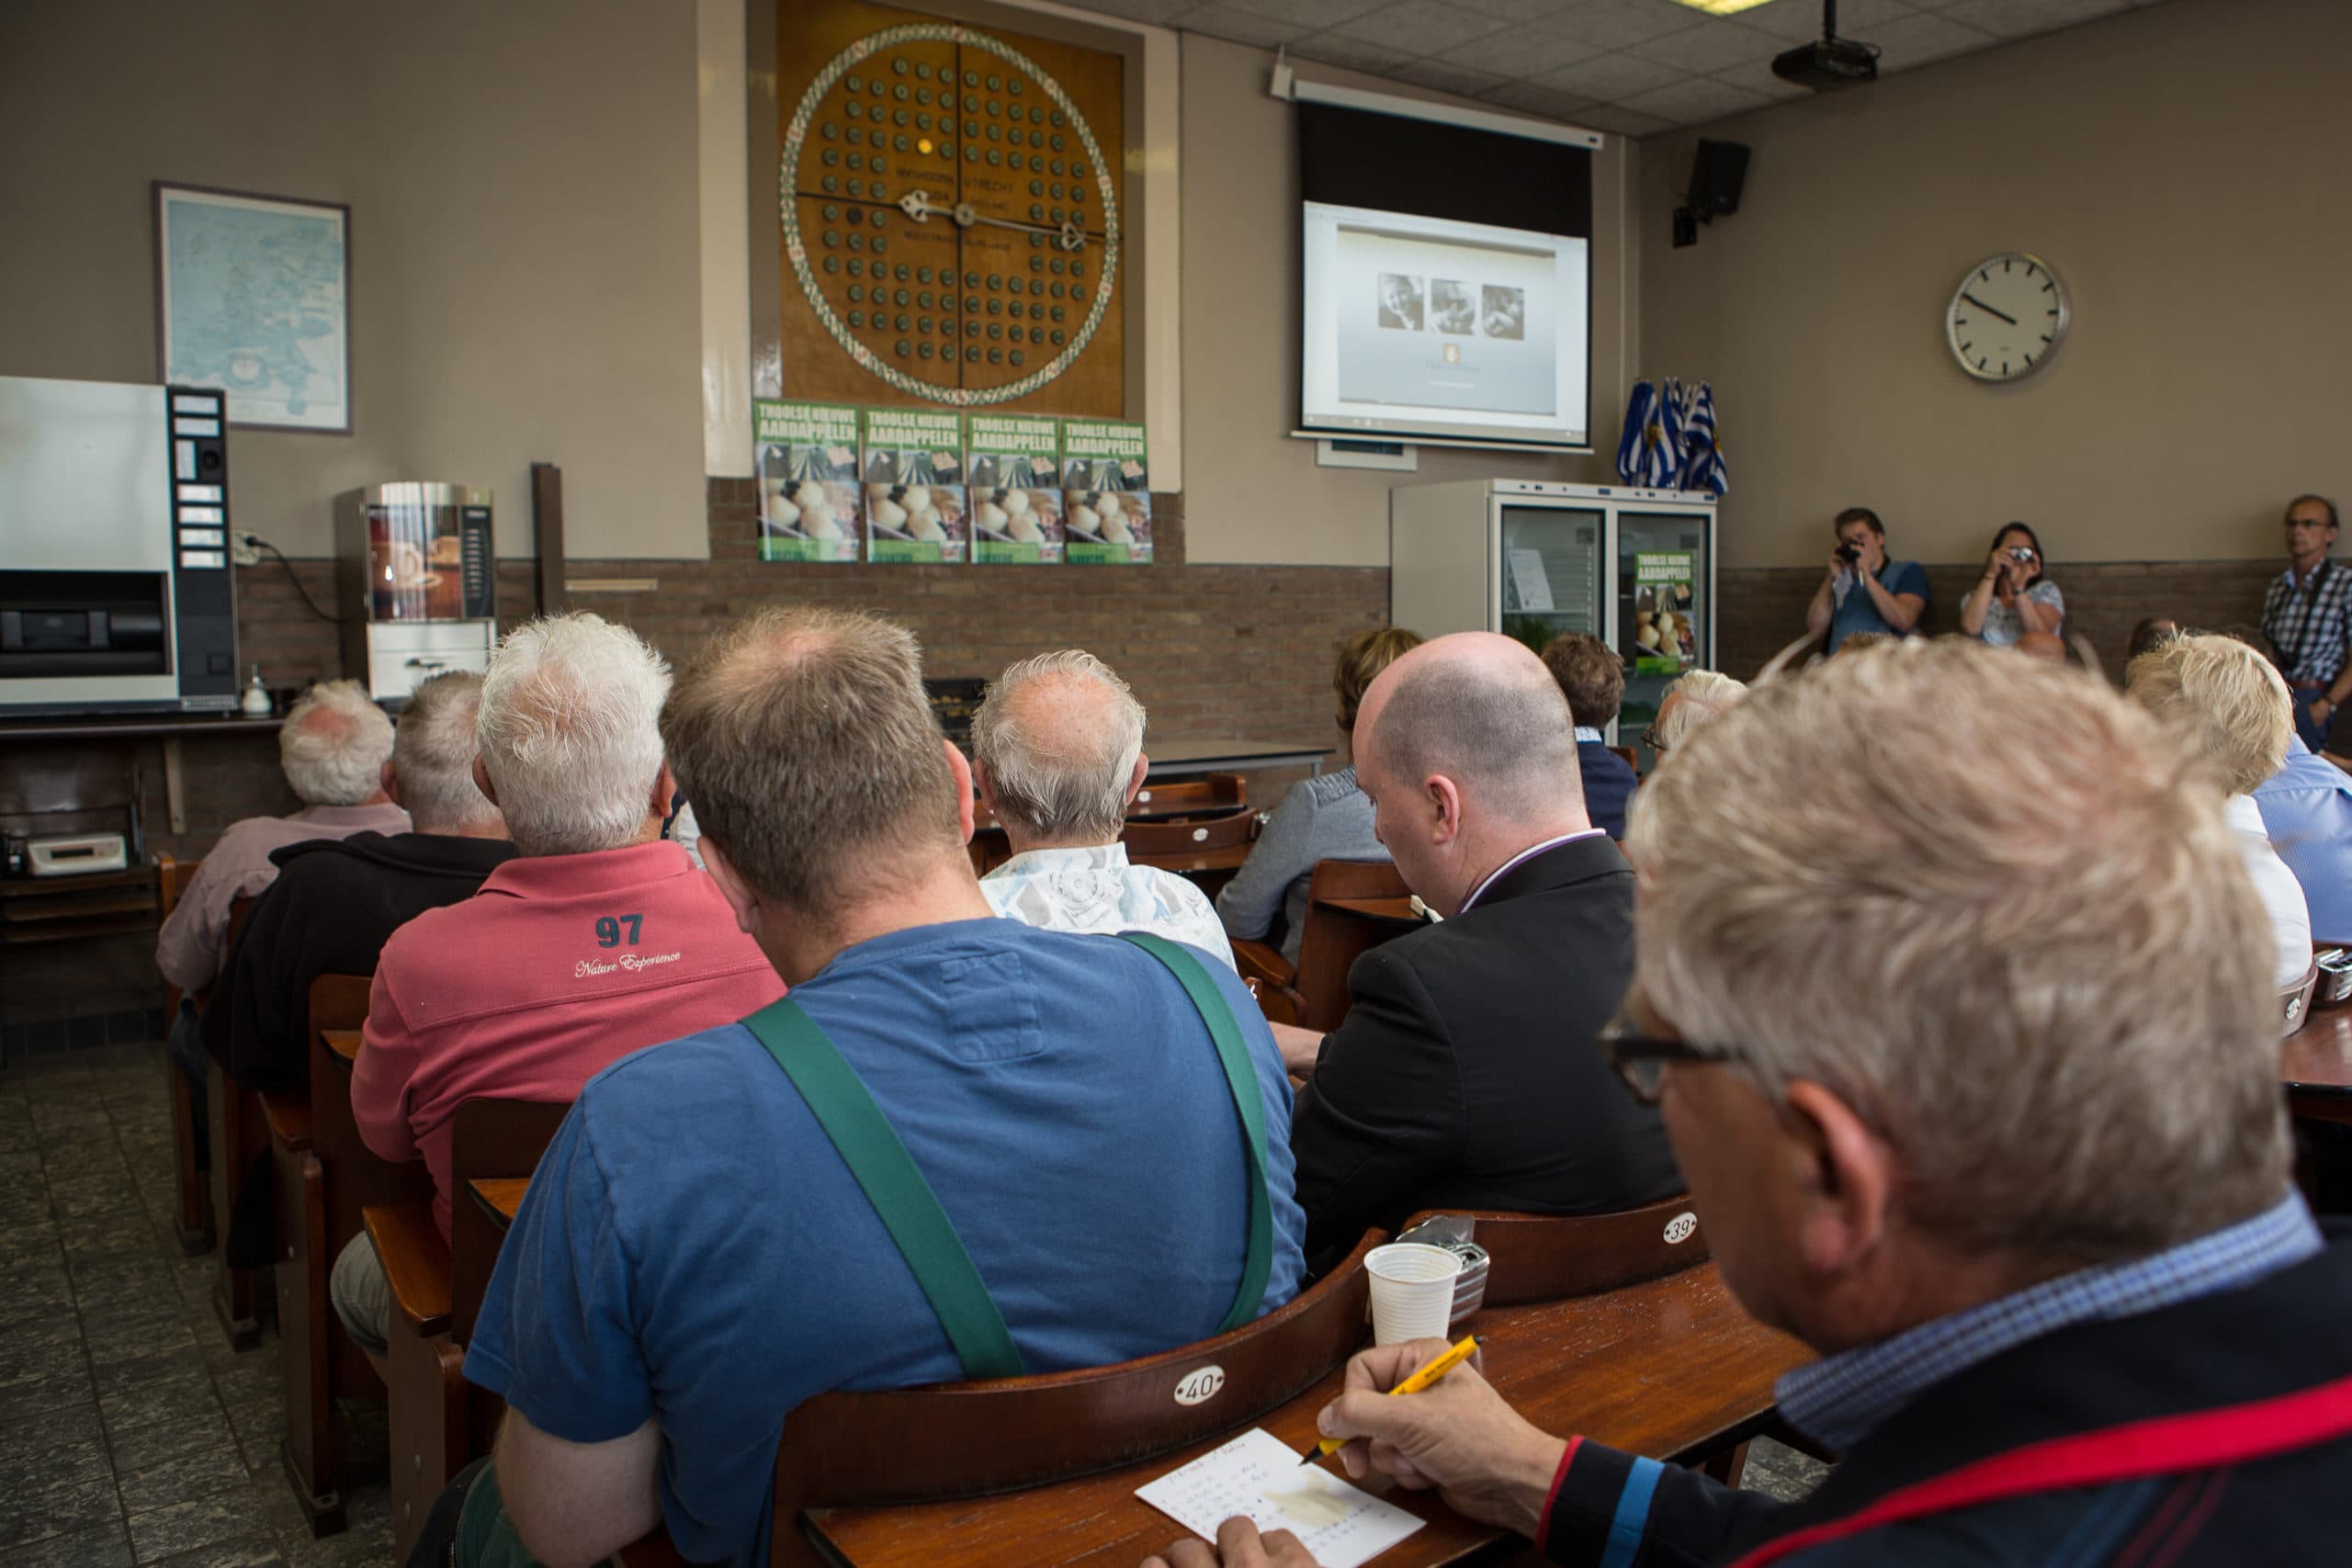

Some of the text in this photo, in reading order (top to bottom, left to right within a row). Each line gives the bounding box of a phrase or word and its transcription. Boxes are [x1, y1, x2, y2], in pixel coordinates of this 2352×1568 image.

[760, 419, 854, 439] AARDAPPELEN
[917, 414, 956, 429] NIEUWE
[869, 426, 957, 446] AARDAPPELEN
[972, 433, 1056, 451] AARDAPPELEN
[1066, 437, 1144, 456] AARDAPPELEN
[595, 913, 643, 948] 97
[575, 952, 681, 978] Nature Experience
[1670, 1219, 1690, 1240] 39
[1185, 1374, 1214, 1400] 40
